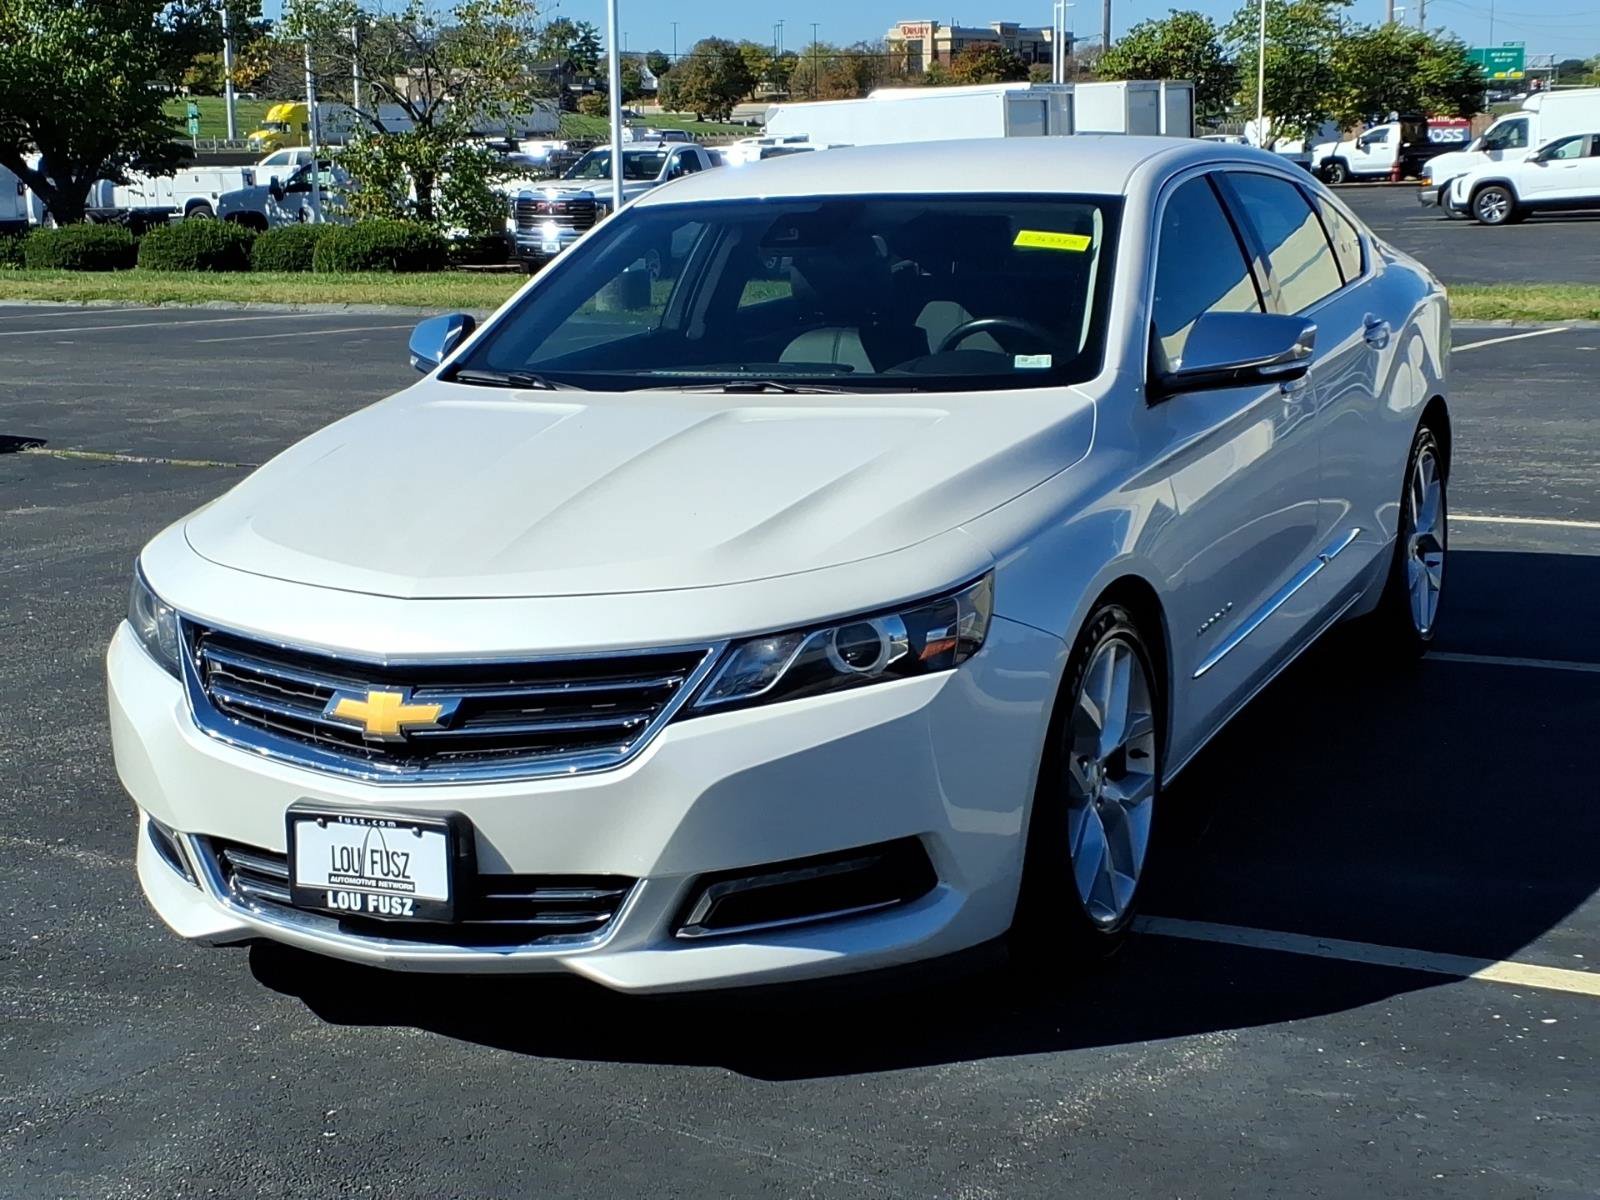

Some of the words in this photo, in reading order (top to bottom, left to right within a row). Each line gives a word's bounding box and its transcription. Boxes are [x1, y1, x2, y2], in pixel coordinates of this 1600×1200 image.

[338, 815, 396, 828] fusz.com
[331, 845, 361, 874] LOU
[370, 848, 411, 879] FUSZ
[330, 876, 376, 886] AUTOMOTIVE
[378, 880, 414, 891] NETWORK
[327, 891, 361, 911] LOU
[368, 896, 414, 917] FUSZ
